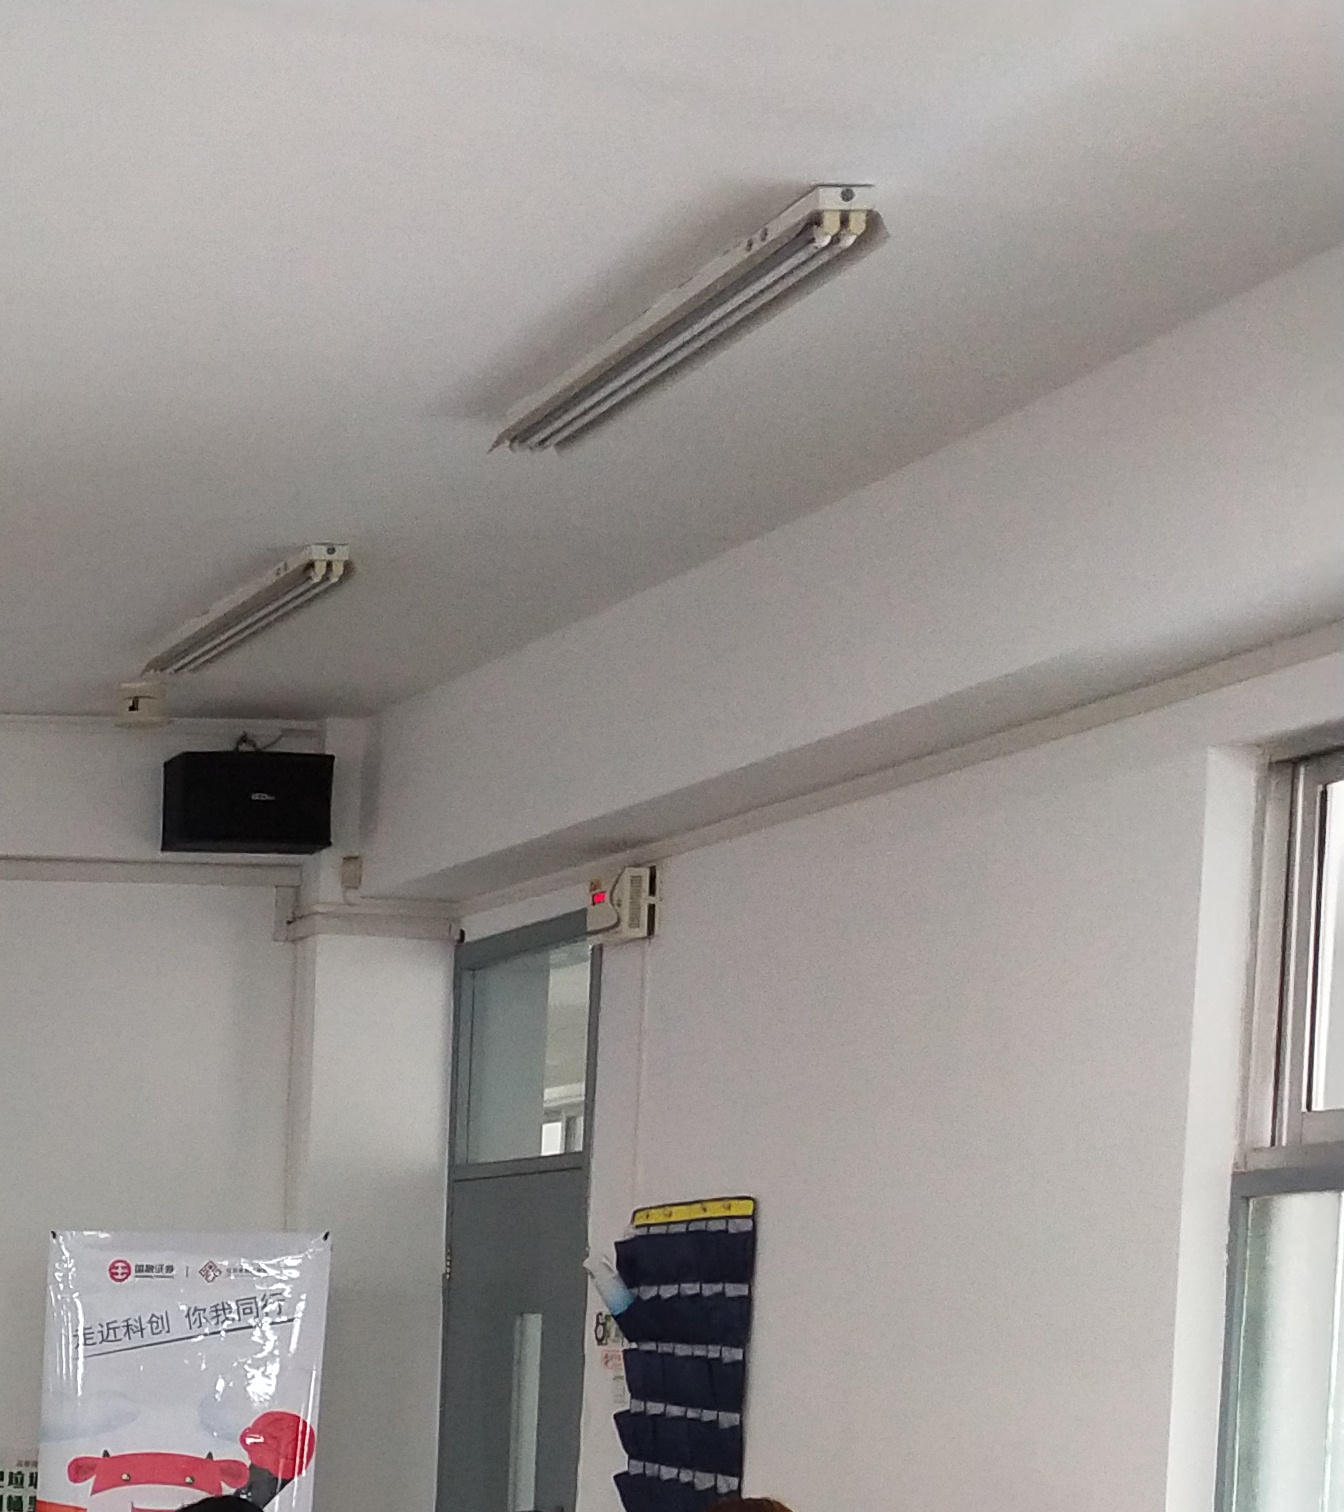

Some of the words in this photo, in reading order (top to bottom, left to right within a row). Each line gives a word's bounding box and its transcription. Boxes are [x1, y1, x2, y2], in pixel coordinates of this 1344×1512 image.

[73, 1310, 171, 1350] 走近科创
[185, 1292, 286, 1330] 你我同行
